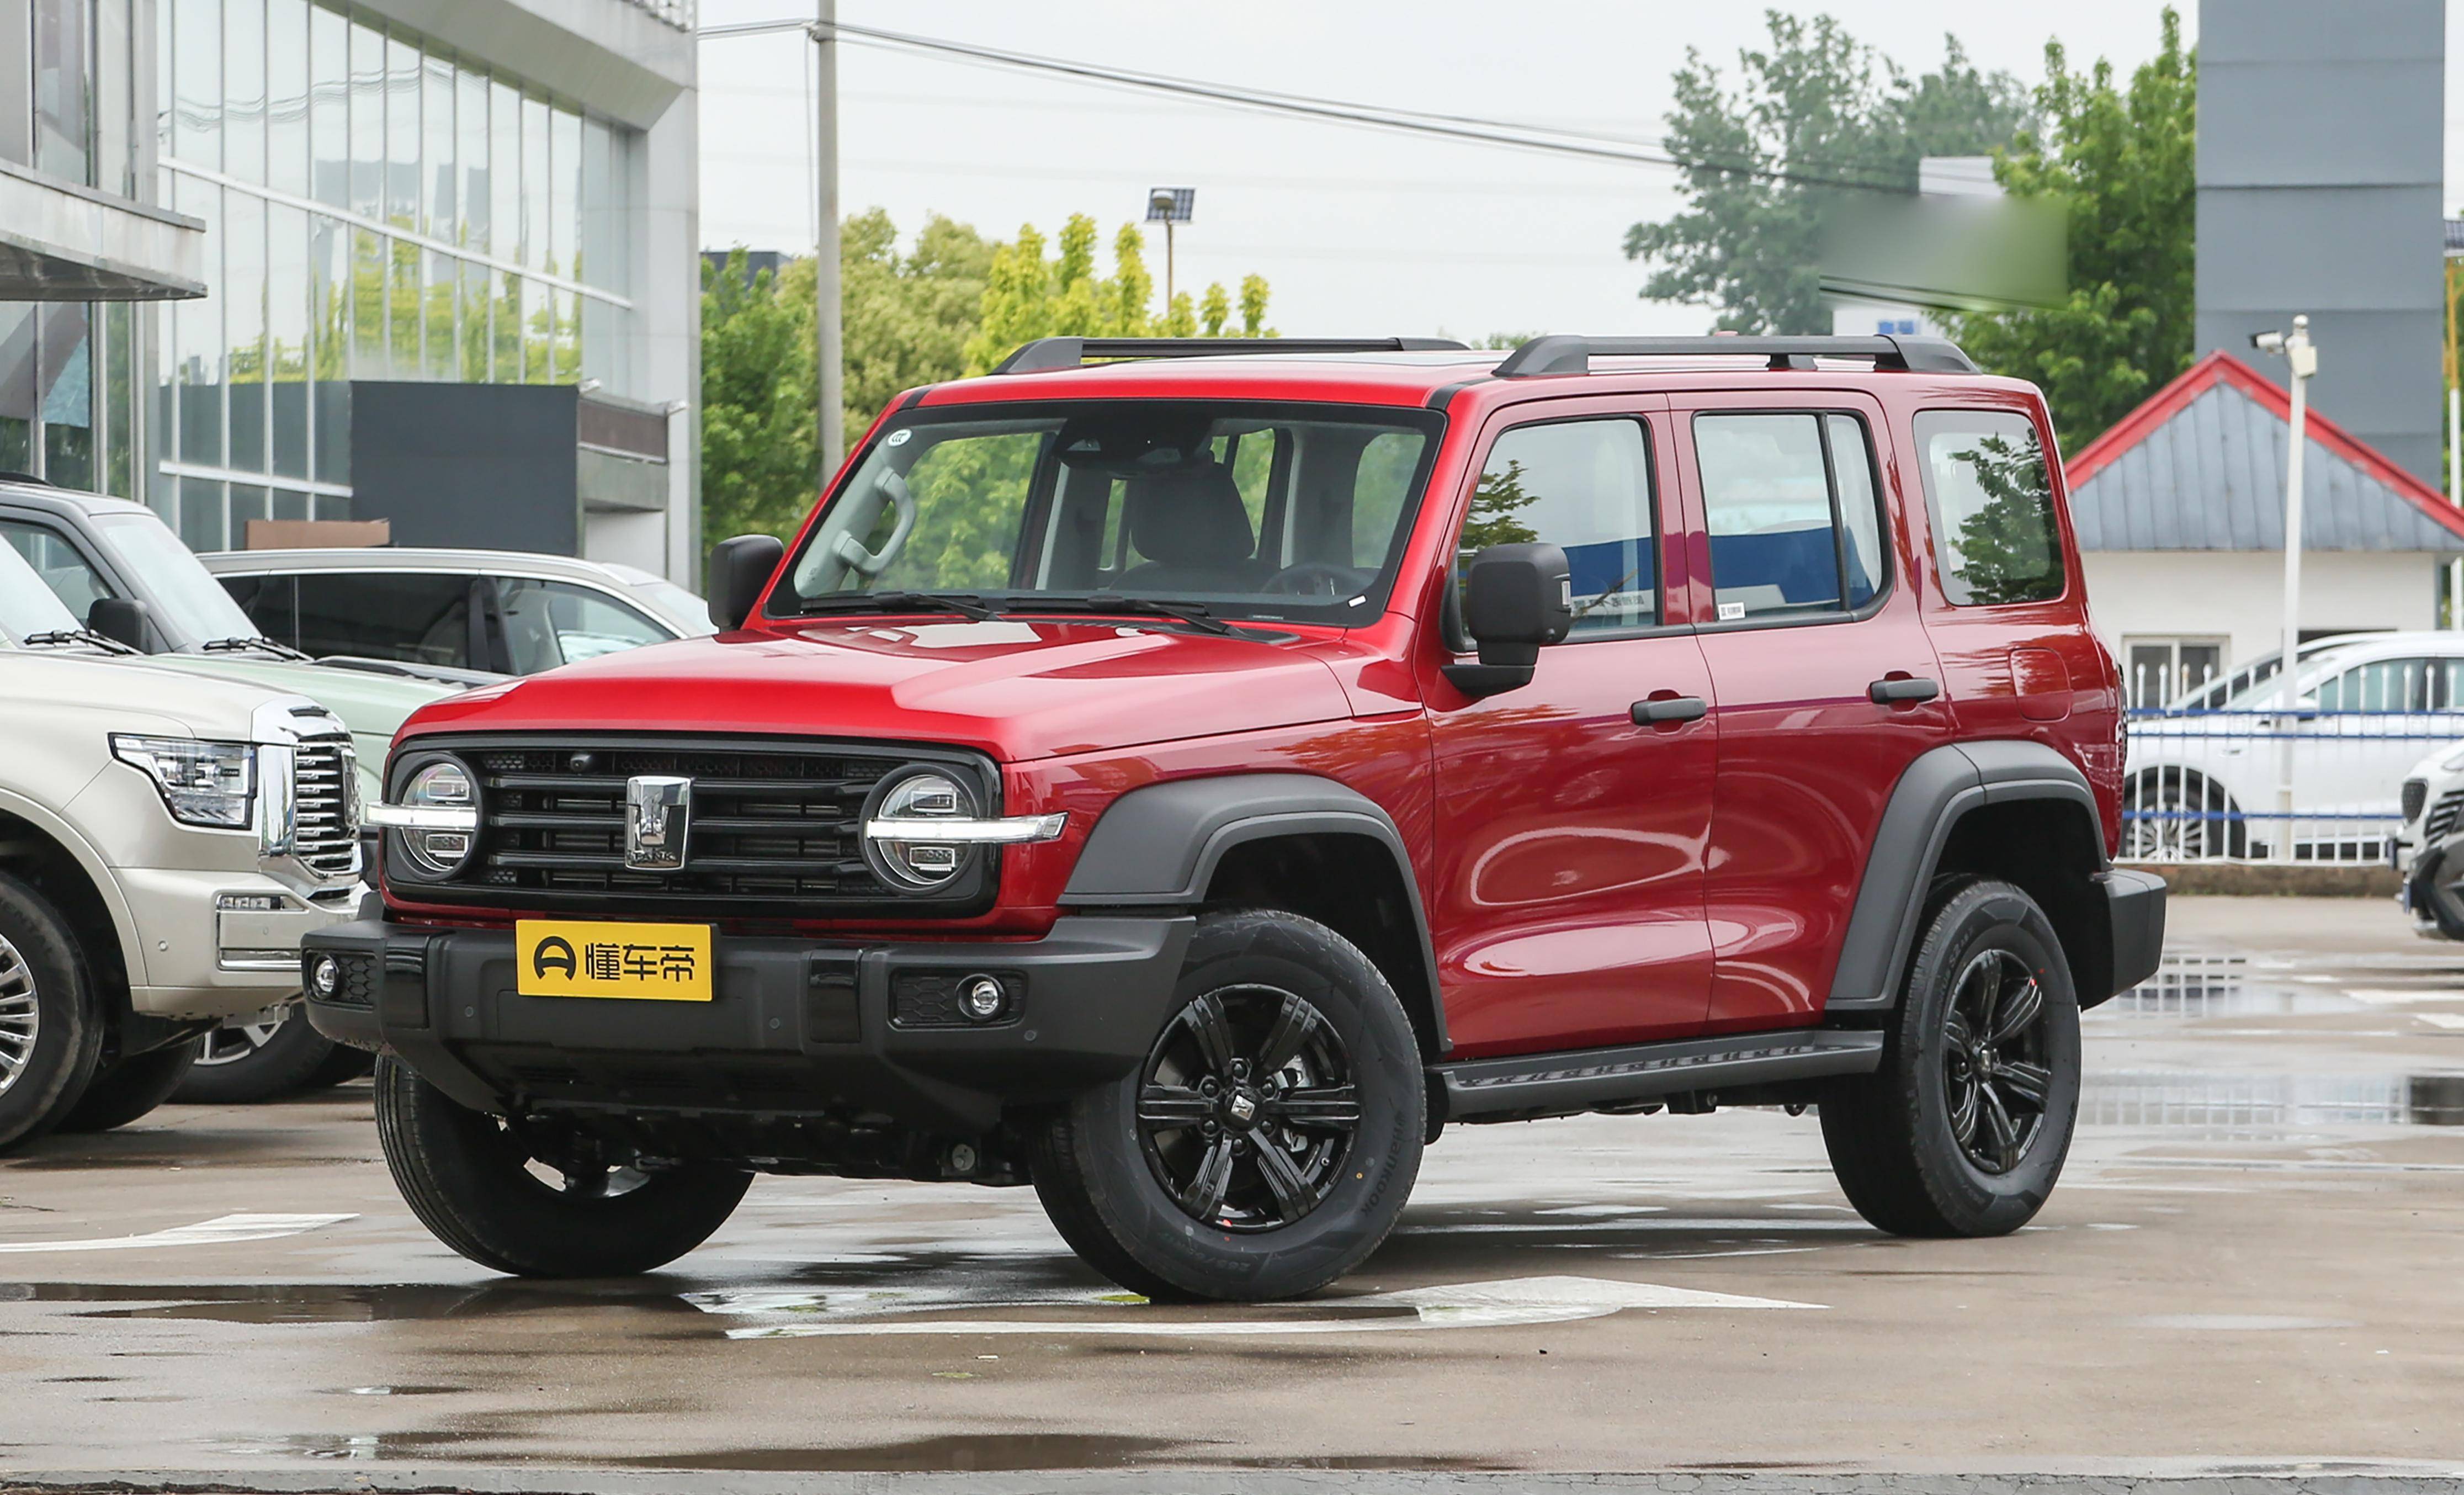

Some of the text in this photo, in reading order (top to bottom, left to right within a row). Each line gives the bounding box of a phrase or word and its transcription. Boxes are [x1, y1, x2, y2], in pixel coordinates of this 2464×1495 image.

[632, 851, 676, 861] TANK
[585, 943, 694, 982] 懂车帝
